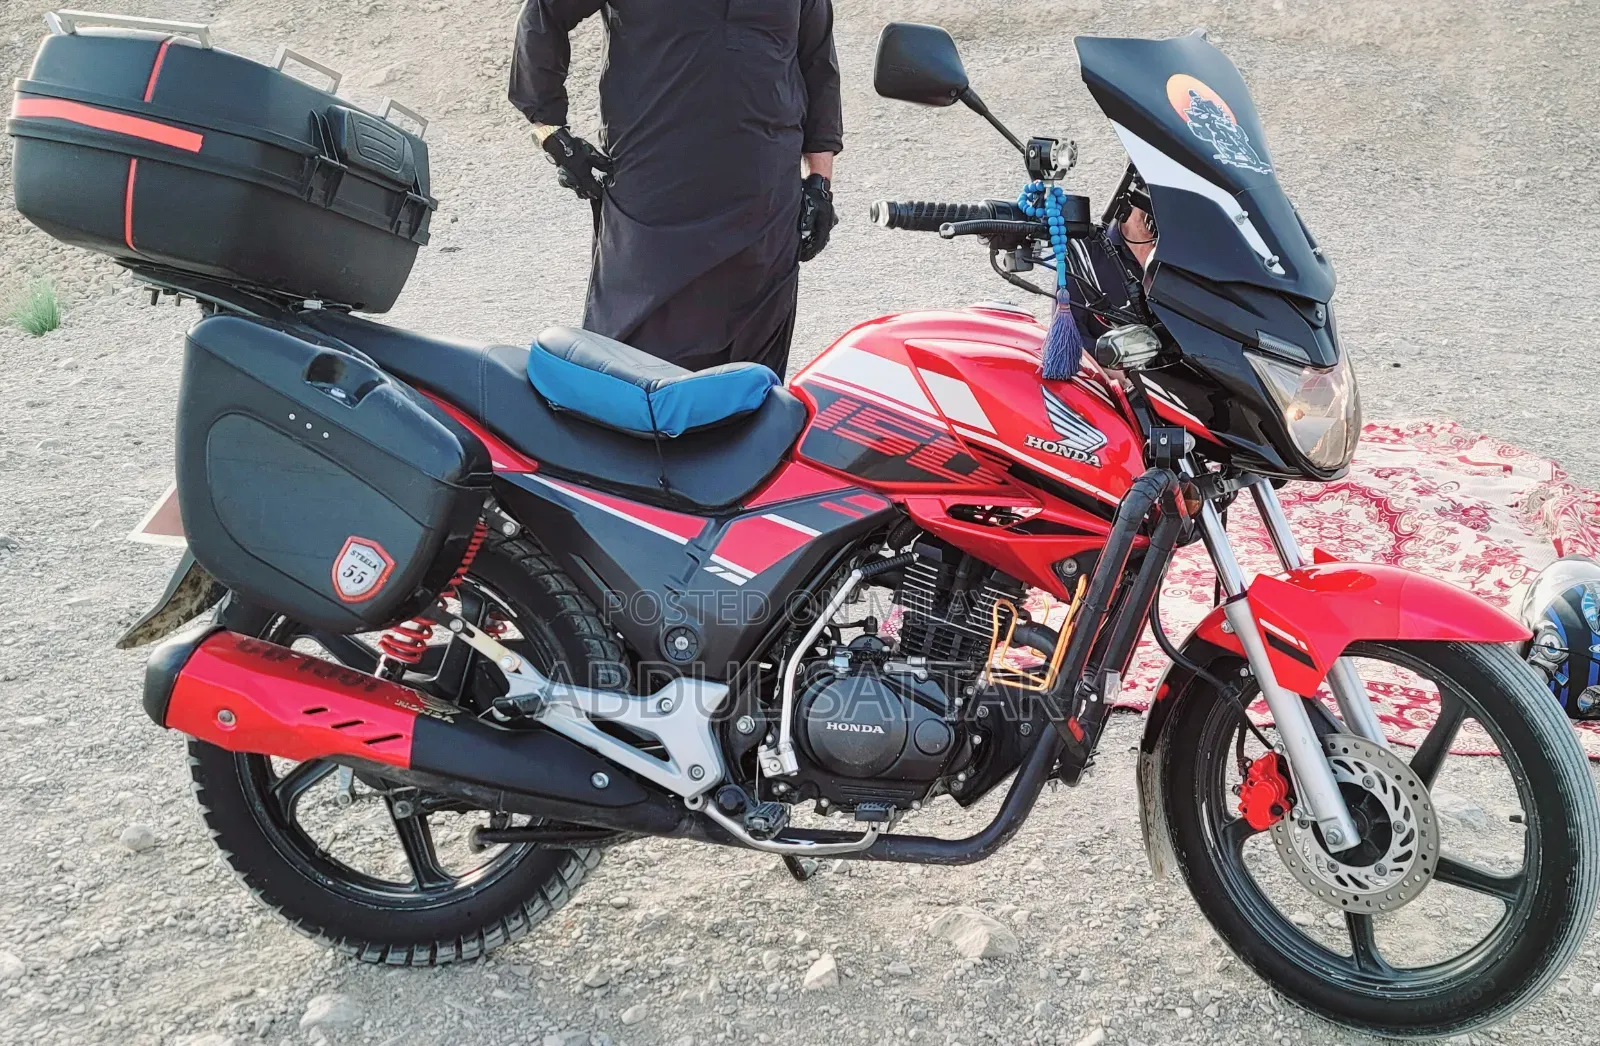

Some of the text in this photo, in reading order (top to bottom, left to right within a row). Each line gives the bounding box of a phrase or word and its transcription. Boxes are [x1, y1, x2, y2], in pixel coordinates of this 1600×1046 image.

[811, 397, 1012, 485] 150
[1024, 434, 1103, 468] HONDA
[350, 549, 378, 570] STEELA
[343, 564, 368, 584] 55
[826, 721, 885, 734] HONDA
